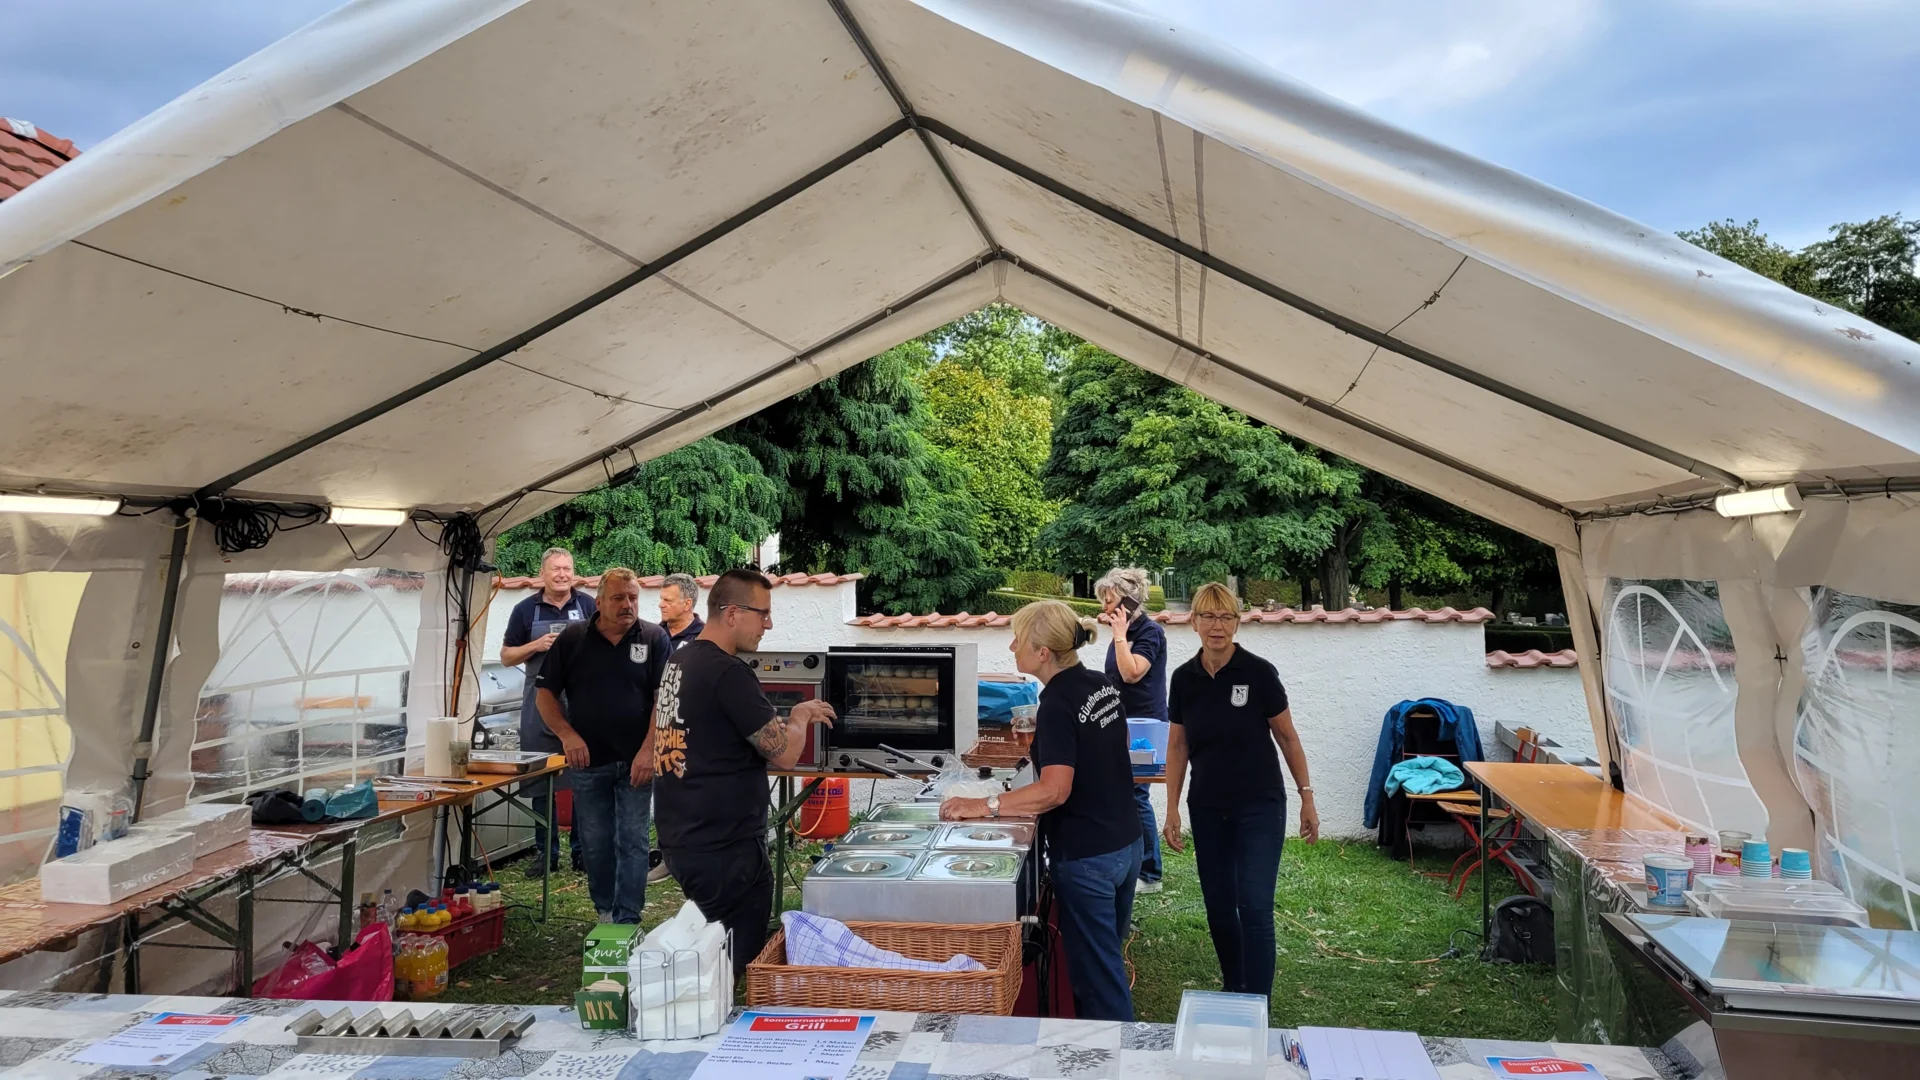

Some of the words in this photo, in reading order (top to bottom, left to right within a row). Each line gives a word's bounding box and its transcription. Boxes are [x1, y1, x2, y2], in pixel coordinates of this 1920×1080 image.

[1078, 685, 1121, 723] Günthersdorfer
[591, 948, 623, 965] pure
[785, 1022, 826, 1030] Grill
[1530, 1064, 1563, 1073] Grill
